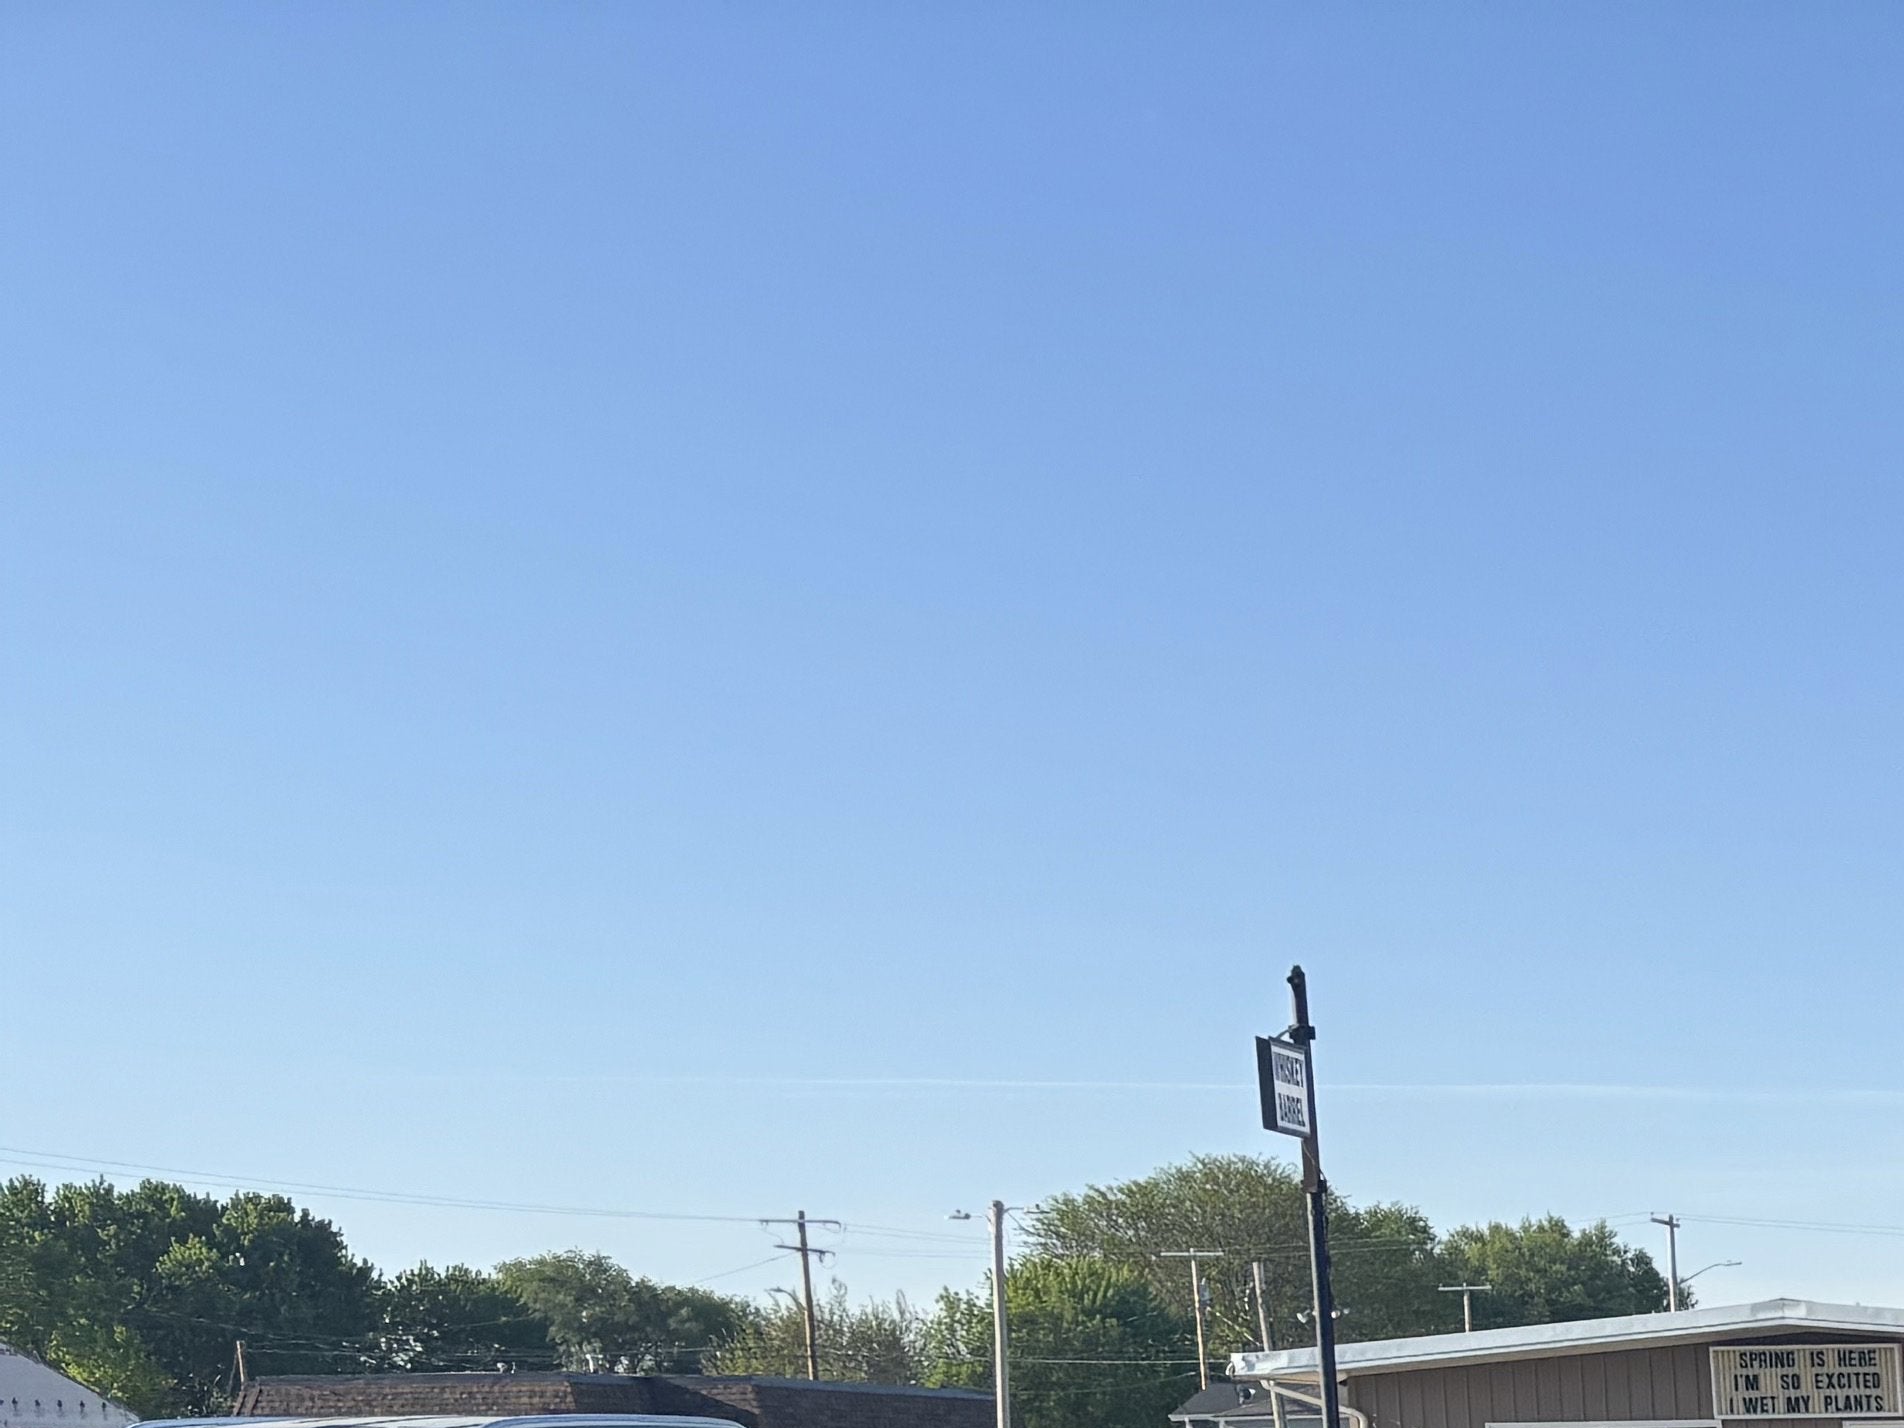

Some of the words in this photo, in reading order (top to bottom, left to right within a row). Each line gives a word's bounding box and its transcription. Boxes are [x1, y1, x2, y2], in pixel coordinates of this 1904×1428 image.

[1739, 1351, 1795, 1369] SPRING
[1810, 1350, 1826, 1368] IS
[1837, 1349, 1878, 1367] HERE
[1734, 1374, 1759, 1392] I'M
[1780, 1373, 1799, 1390] SO
[1814, 1372, 1881, 1390] EXCITED
[1729, 1397, 1734, 1414] I
[1743, 1395, 1777, 1414] WET
[1786, 1395, 1811, 1413] MY
[1824, 1394, 1884, 1413] PLANTS
